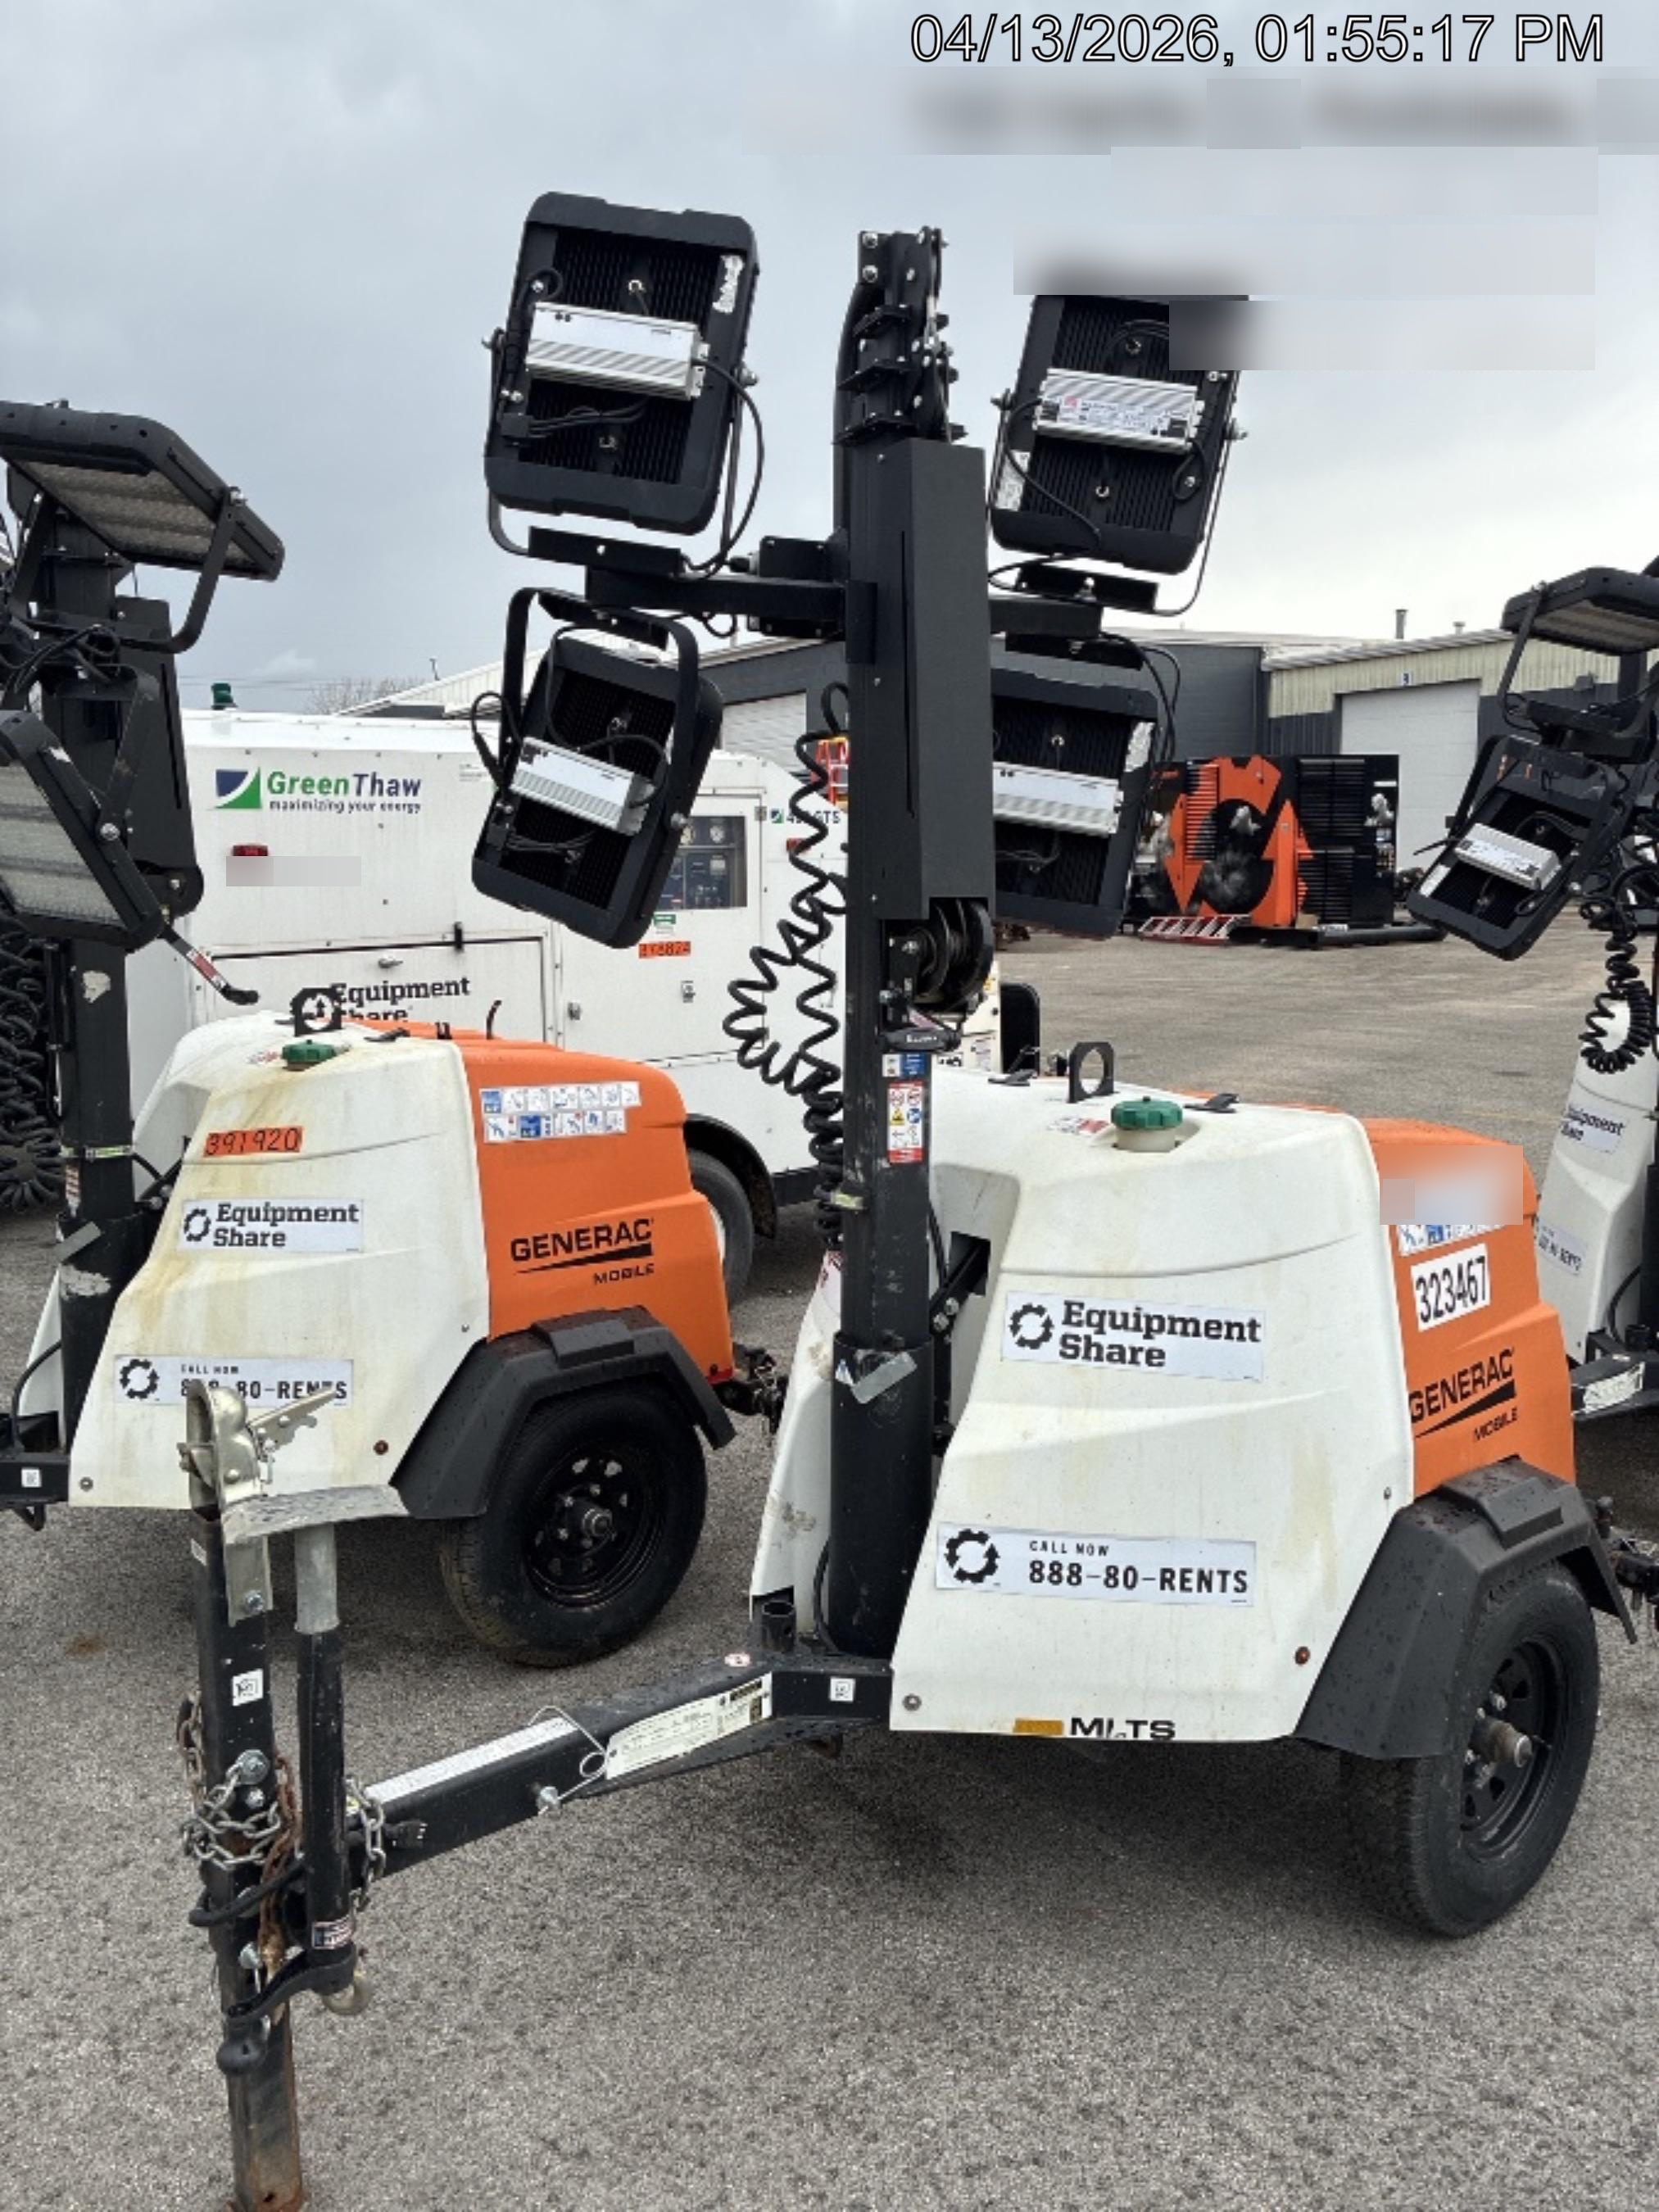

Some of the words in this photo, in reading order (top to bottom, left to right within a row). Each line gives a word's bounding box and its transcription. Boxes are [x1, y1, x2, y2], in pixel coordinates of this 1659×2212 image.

[269, 799, 345, 814] maximizing
[347, 802, 376, 813] your
[379, 802, 421, 813] energy
[331, 977, 469, 1007] Equipment
[216, 1202, 360, 1227] Equipment
[213, 1227, 287, 1247] Share
[510, 1218, 652, 1262] GENERAC
[593, 1263, 655, 1285] MOBILE
[1416, 1255, 1486, 1323] 323467
[1062, 1300, 1262, 1344] Equipment
[1058, 1334, 1167, 1367] Share
[1408, 1348, 1514, 1424] GENERAC
[1474, 1406, 1518, 1442] MOBILE
[1028, 1540, 1067, 1555] CALL
[1076, 1543, 1111, 1558] NOW
[1028, 1560, 1249, 1594] 888-80-RENTS
